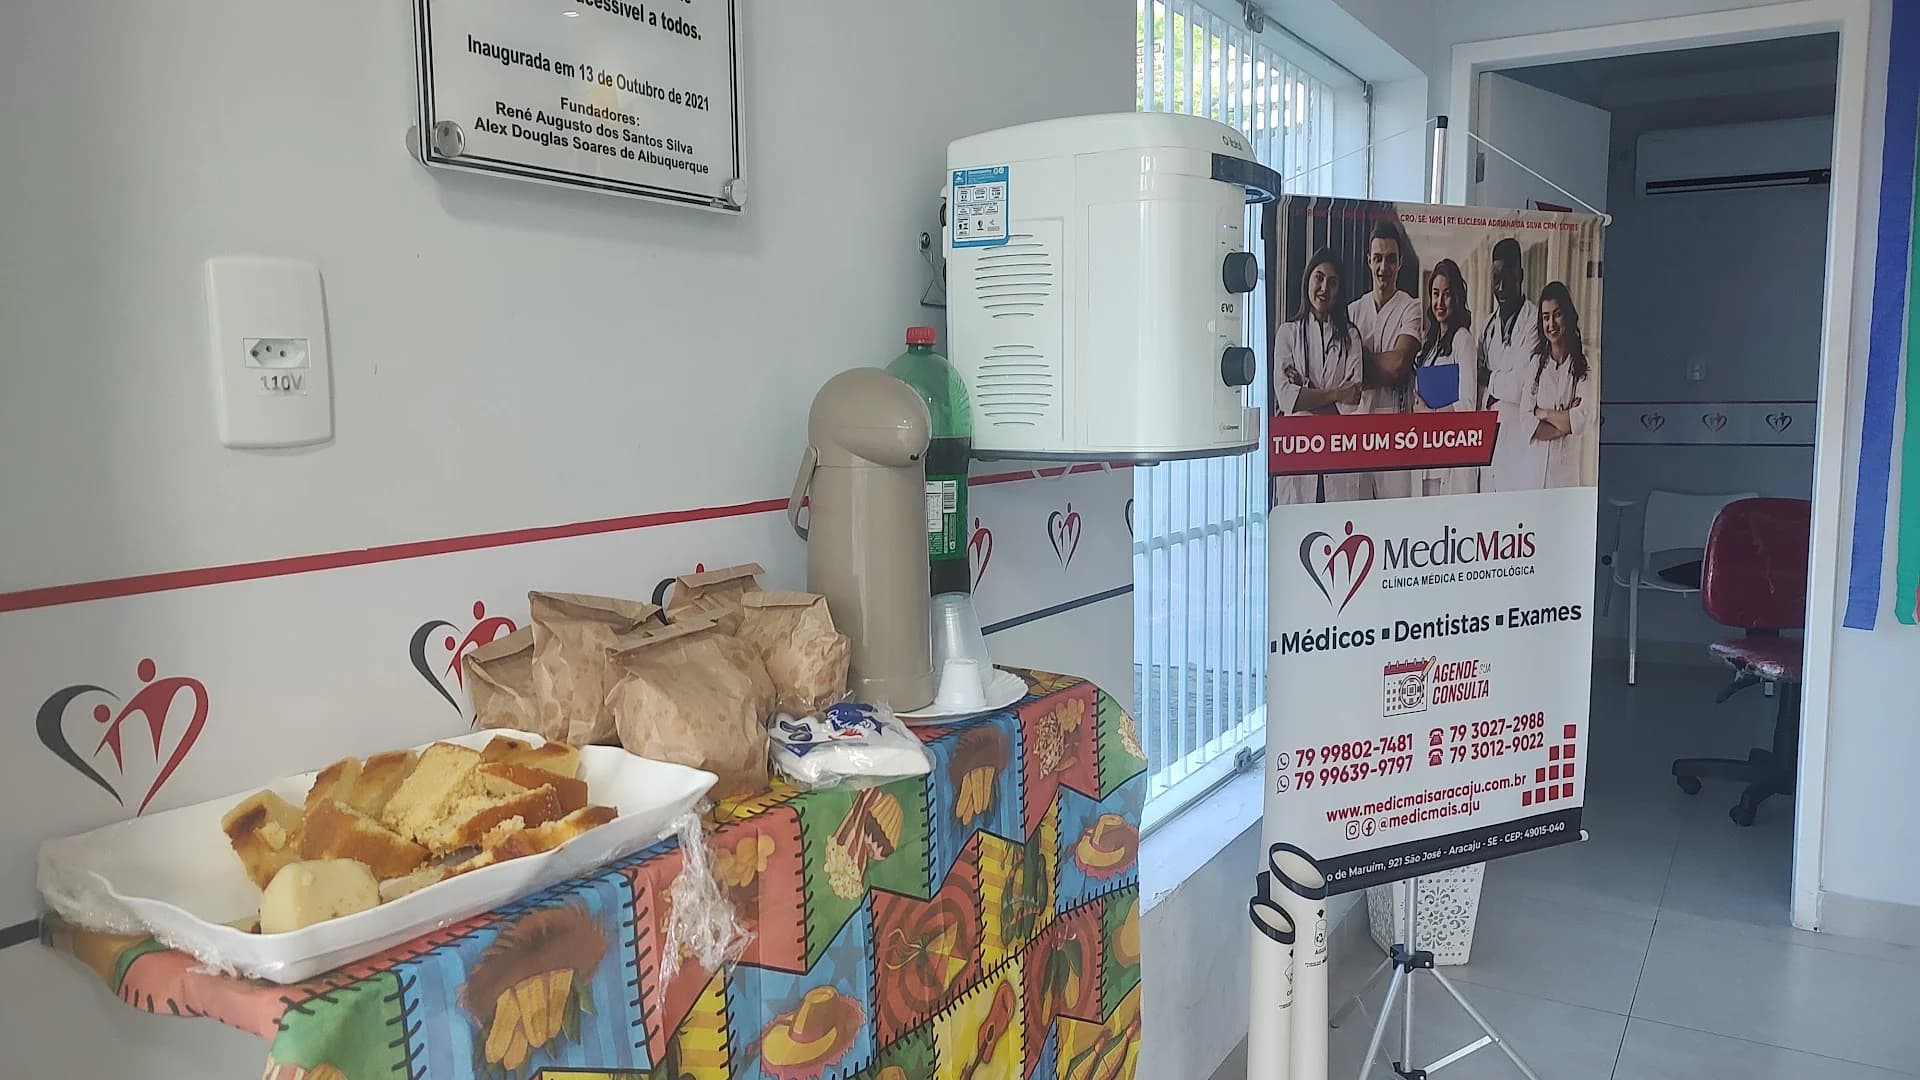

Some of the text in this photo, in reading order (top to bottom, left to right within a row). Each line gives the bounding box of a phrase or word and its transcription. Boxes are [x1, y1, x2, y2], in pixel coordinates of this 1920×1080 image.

[576, 0, 702, 40] essível a todos.
[468, 34, 709, 112] Inaugurada em 13 de Outubro de 2021
[496, 101, 693, 155] René Augusto dos Santos Silva
[561, 97, 640, 126] Fundadores:
[474, 116, 709, 175] Alex Douglas Soares de Albuquerque
[260, 375, 303, 391] 110V
[1273, 427, 1483, 454] TUDO EM UM SÓ LUGAR!
[1383, 523, 1536, 570] MedicMais
[1382, 565, 1535, 589] CLÍNICA MÉDICA E ODONTOLÓGICA
[1281, 604, 1582, 655] Médicos Dentistas Exames
[1432, 659, 1479, 684] AGENDE
[1432, 680, 1490, 704] CONSULTA
[1449, 711, 1544, 743] 79 3027-2988
[1295, 733, 1413, 768] 79 99802-7481
[1449, 731, 1544, 764] 79 3012-9022
[1294, 754, 1413, 790] 79 99639-9797
[1326, 773, 1527, 822] www.medicmaisaracaju.com.br
[1378, 798, 1481, 832] @medicmais.aju
[1335, 869, 1347, 880] de
[1388, 857, 1403, 869] 921
[1404, 854, 1421, 865] São
[1422, 847, 1442, 861] José
[1448, 840, 1481, 856] Aracaju
[1487, 836, 1498, 847] SE
[1504, 831, 1523, 844] CEP:
[1524, 821, 1565, 838] 49015-040
